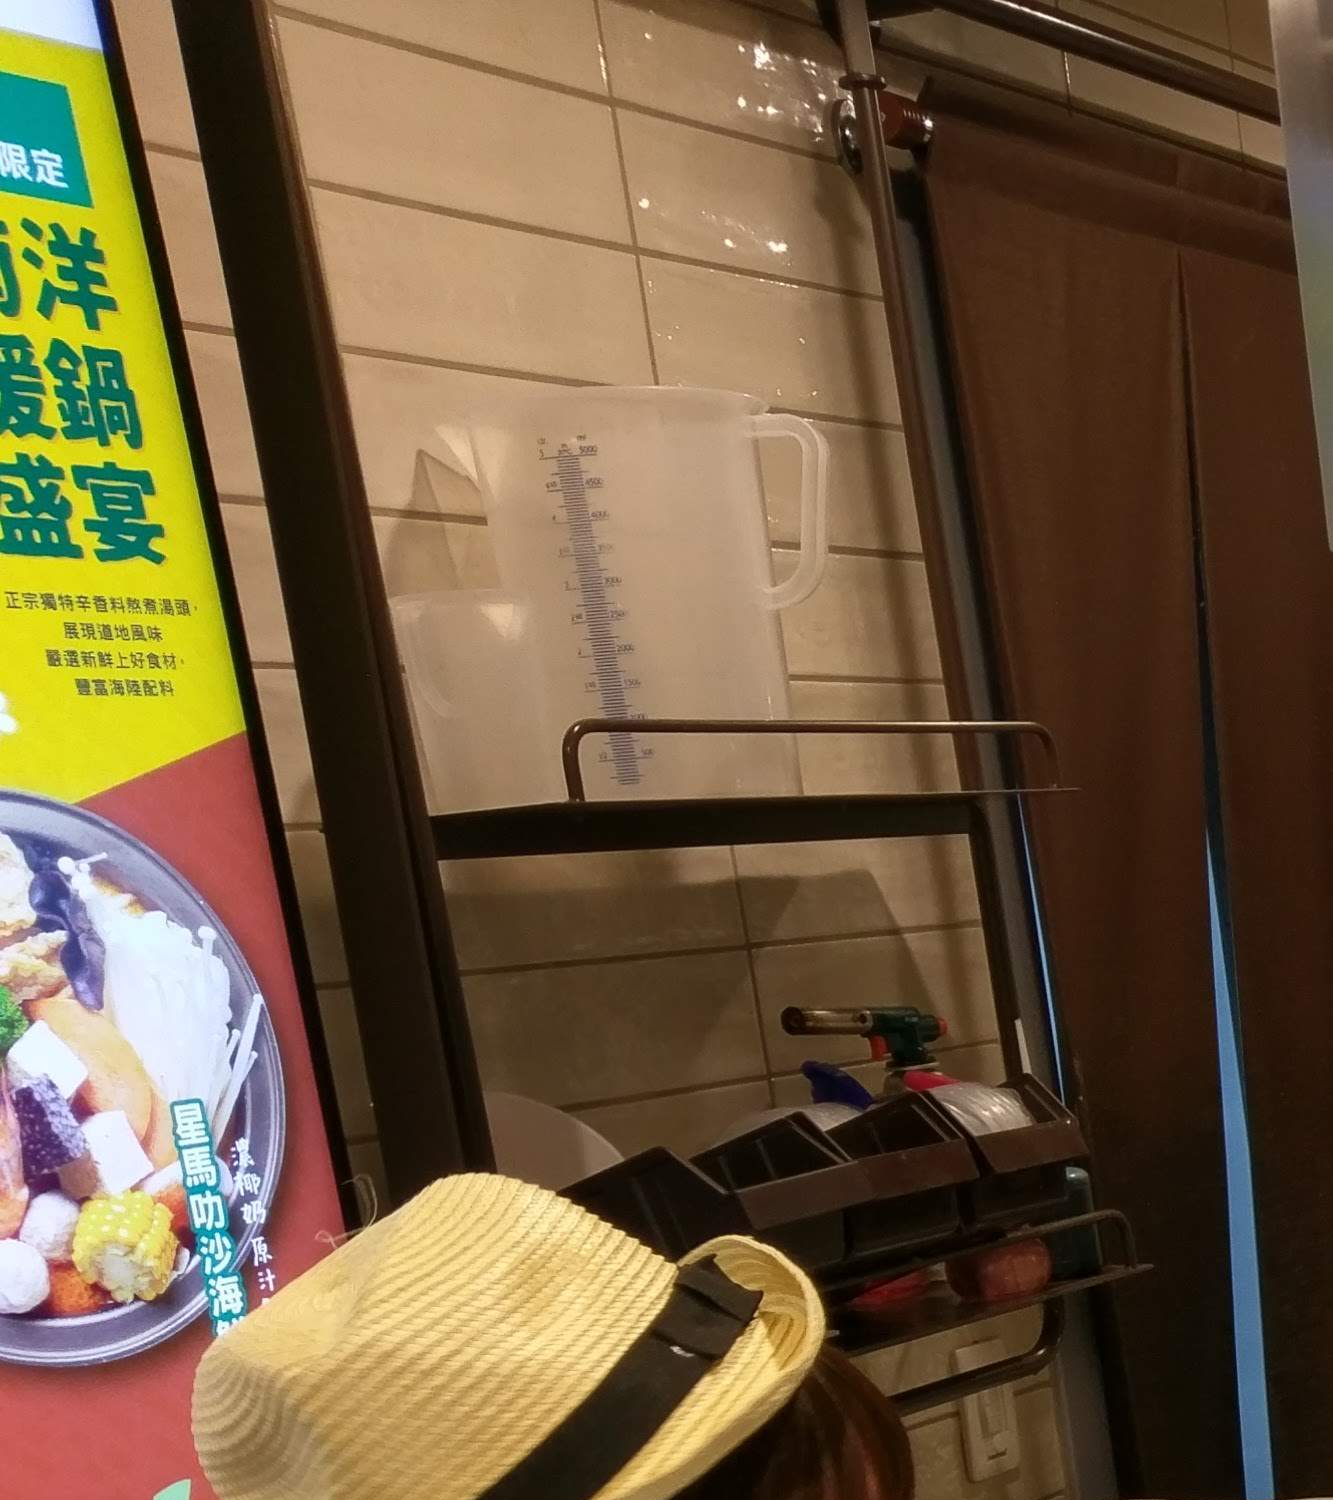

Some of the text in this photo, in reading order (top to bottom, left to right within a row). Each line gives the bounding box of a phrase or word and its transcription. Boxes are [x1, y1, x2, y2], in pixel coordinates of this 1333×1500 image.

[0, 217, 118, 331] 洋
[0, 451, 167, 566] 盛宴
[63, 621, 164, 643] 展現道地風味
[74, 677, 175, 697] 豐富海陸配料
